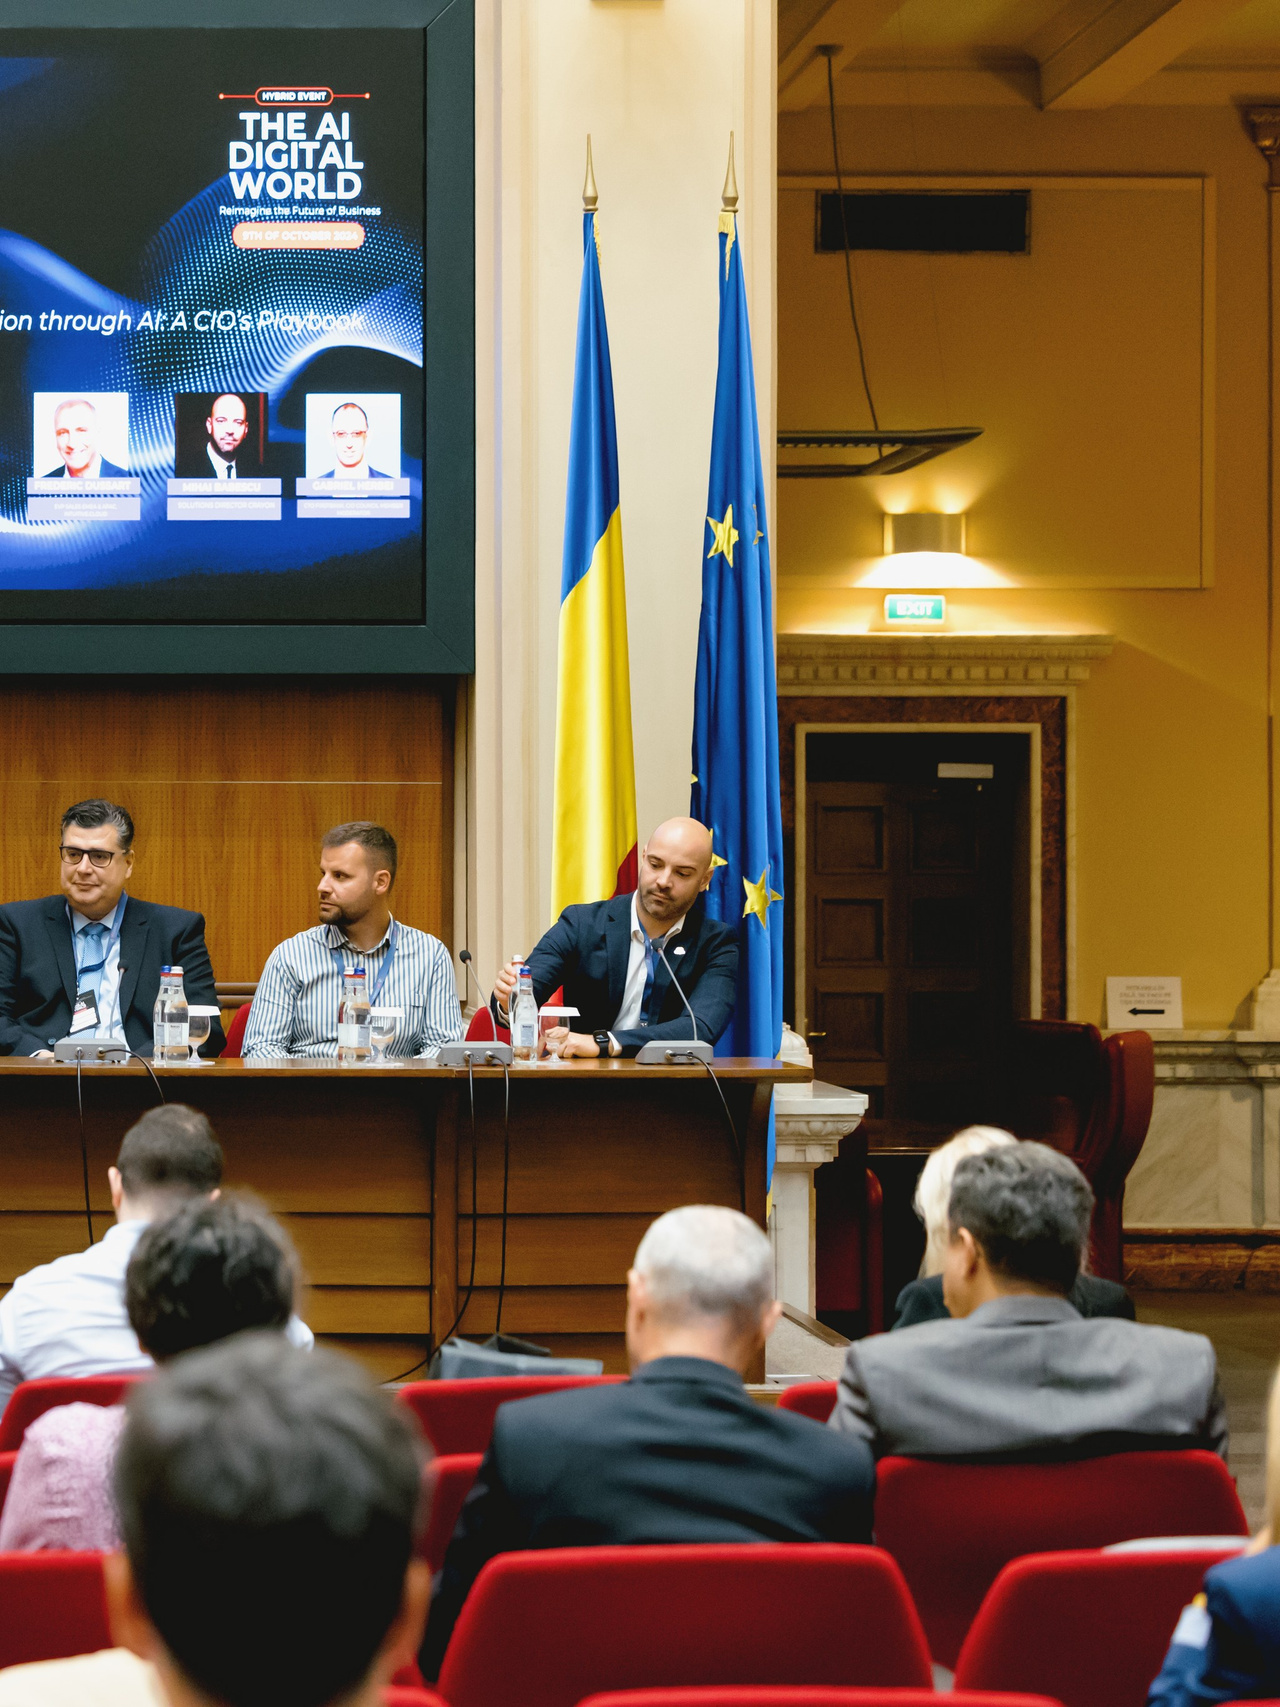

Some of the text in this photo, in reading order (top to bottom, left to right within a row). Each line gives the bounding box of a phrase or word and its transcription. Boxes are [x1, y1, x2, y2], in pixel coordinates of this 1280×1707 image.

[262, 92, 327, 101] HYBRID EVENT
[239, 112, 350, 141] THE AI
[228, 141, 365, 170] DIGITAL
[228, 171, 363, 200] WORLD
[219, 205, 382, 218] Reimagine the Future of Business
[265, 230, 279, 241] OF
[281, 230, 332, 241] OCTOBER
[333, 230, 359, 241] 2024
[39, 309, 132, 336] through
[170, 310, 188, 332] A
[193, 310, 252, 332] CIO's
[257, 309, 365, 336] Playbook
[182, 482, 212, 492] MIHAI
[896, 601, 935, 616] EXIT
